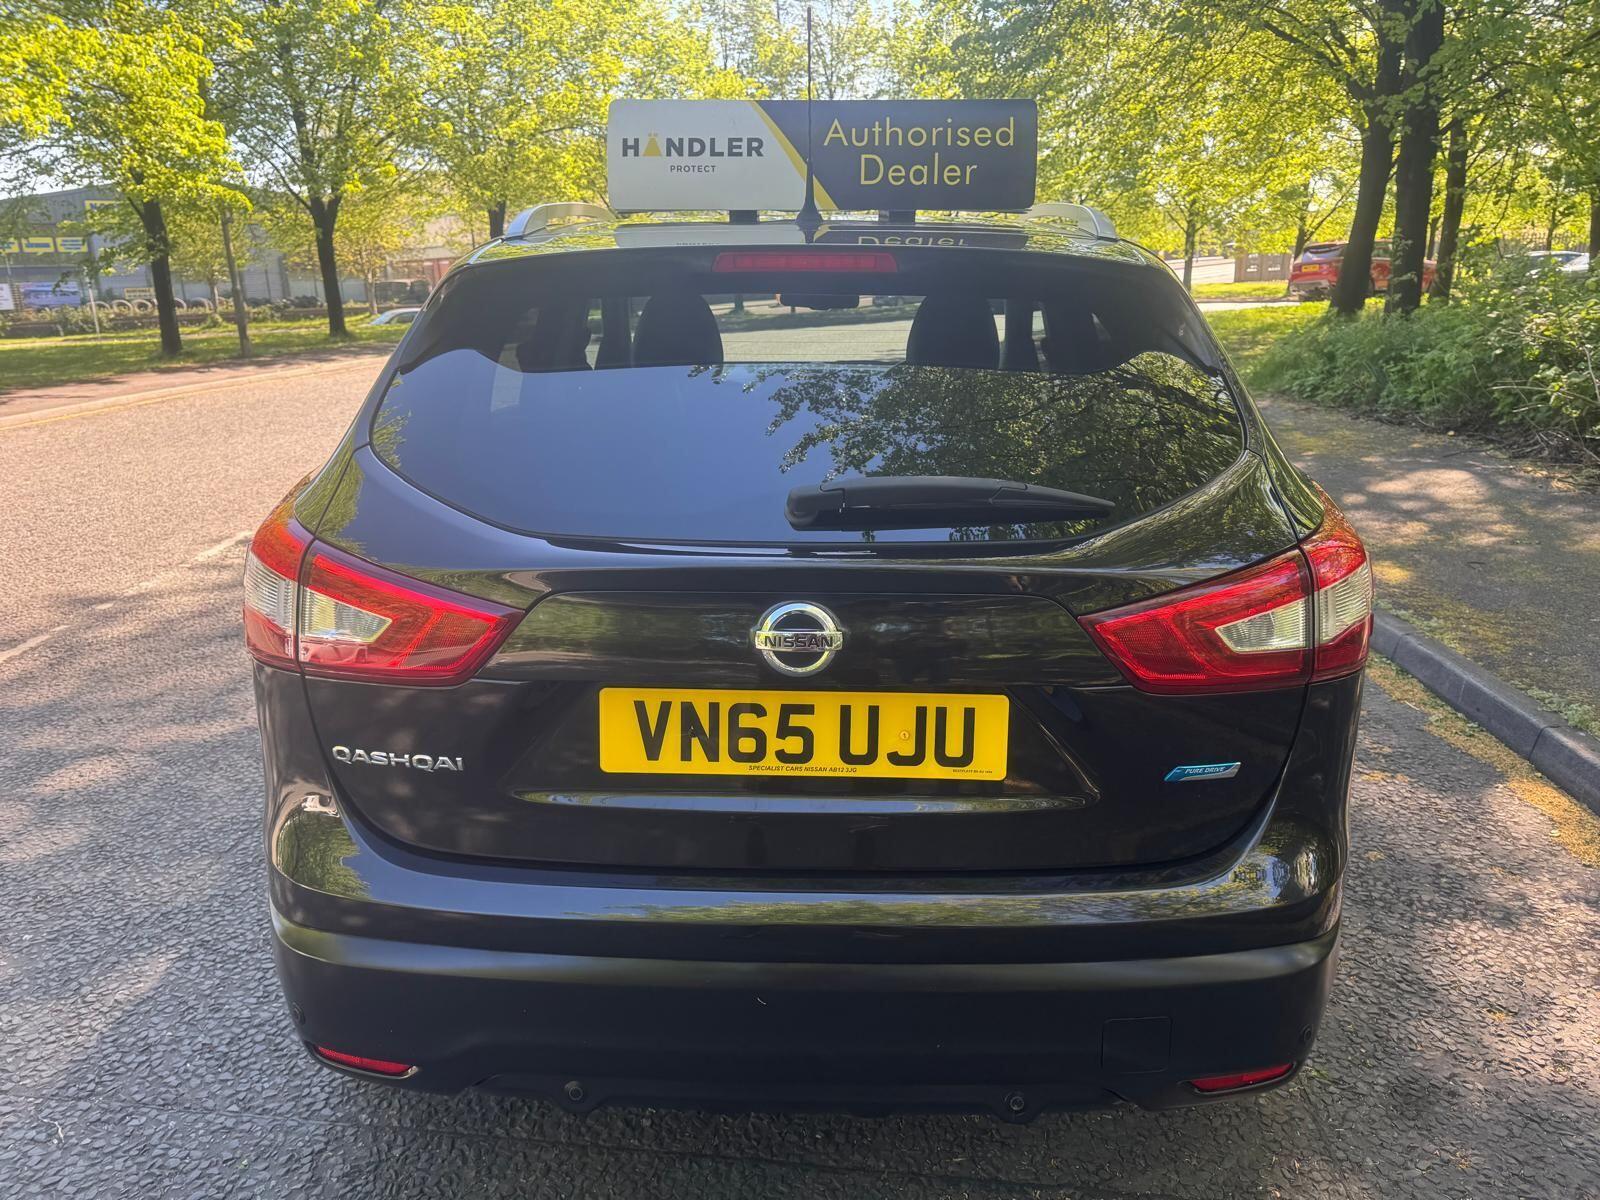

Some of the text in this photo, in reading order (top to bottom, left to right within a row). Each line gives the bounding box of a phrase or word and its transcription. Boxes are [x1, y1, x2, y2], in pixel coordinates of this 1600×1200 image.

[823, 116, 1014, 147] Authorised
[670, 164, 717, 173] PROTECT
[860, 152, 978, 186] Dealer
[764, 635, 833, 648] NISSAN
[633, 700, 976, 768] VN65 UJU
[332, 745, 464, 773] QASHQAI
